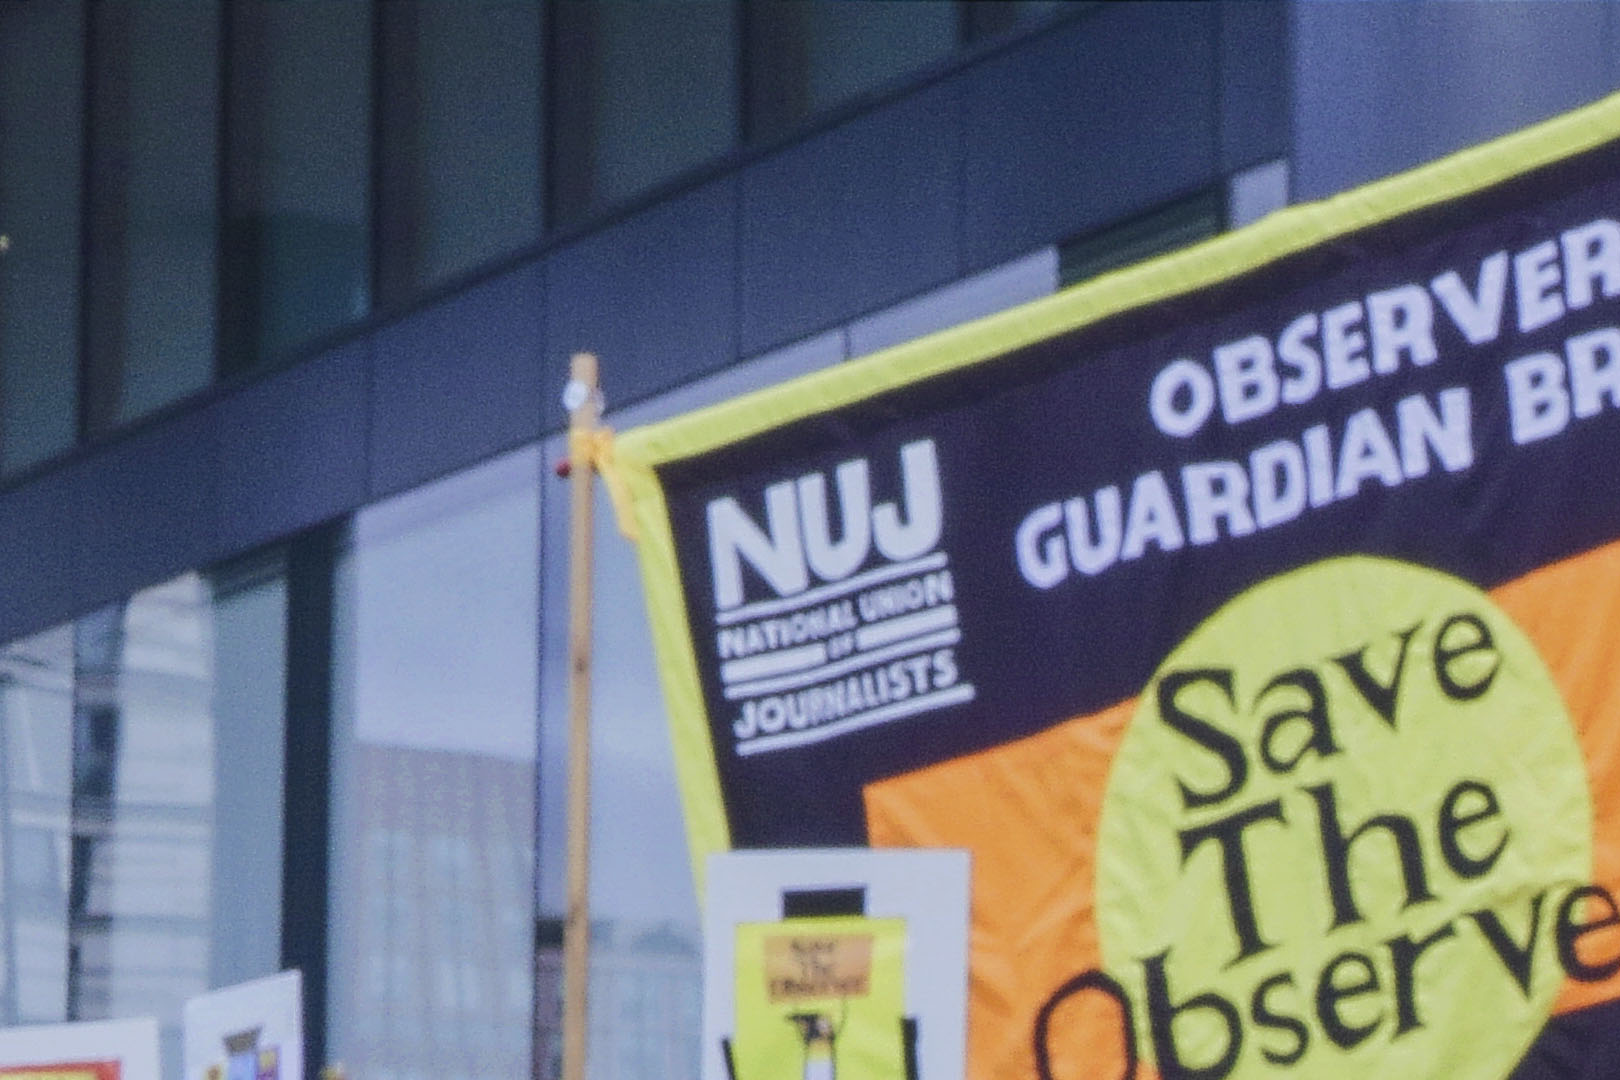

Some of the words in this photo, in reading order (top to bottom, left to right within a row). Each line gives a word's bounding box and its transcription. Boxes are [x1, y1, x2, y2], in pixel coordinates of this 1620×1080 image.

[706, 438, 944, 608] NUJ
[1015, 386, 1475, 590] GUARDIAN
[716, 599, 858, 660] NATIONAL
[858, 569, 954, 623] UNION
[732, 648, 958, 740] JOURNALISTS
[1153, 609, 1503, 809] Save
[1177, 779, 1511, 969] The
